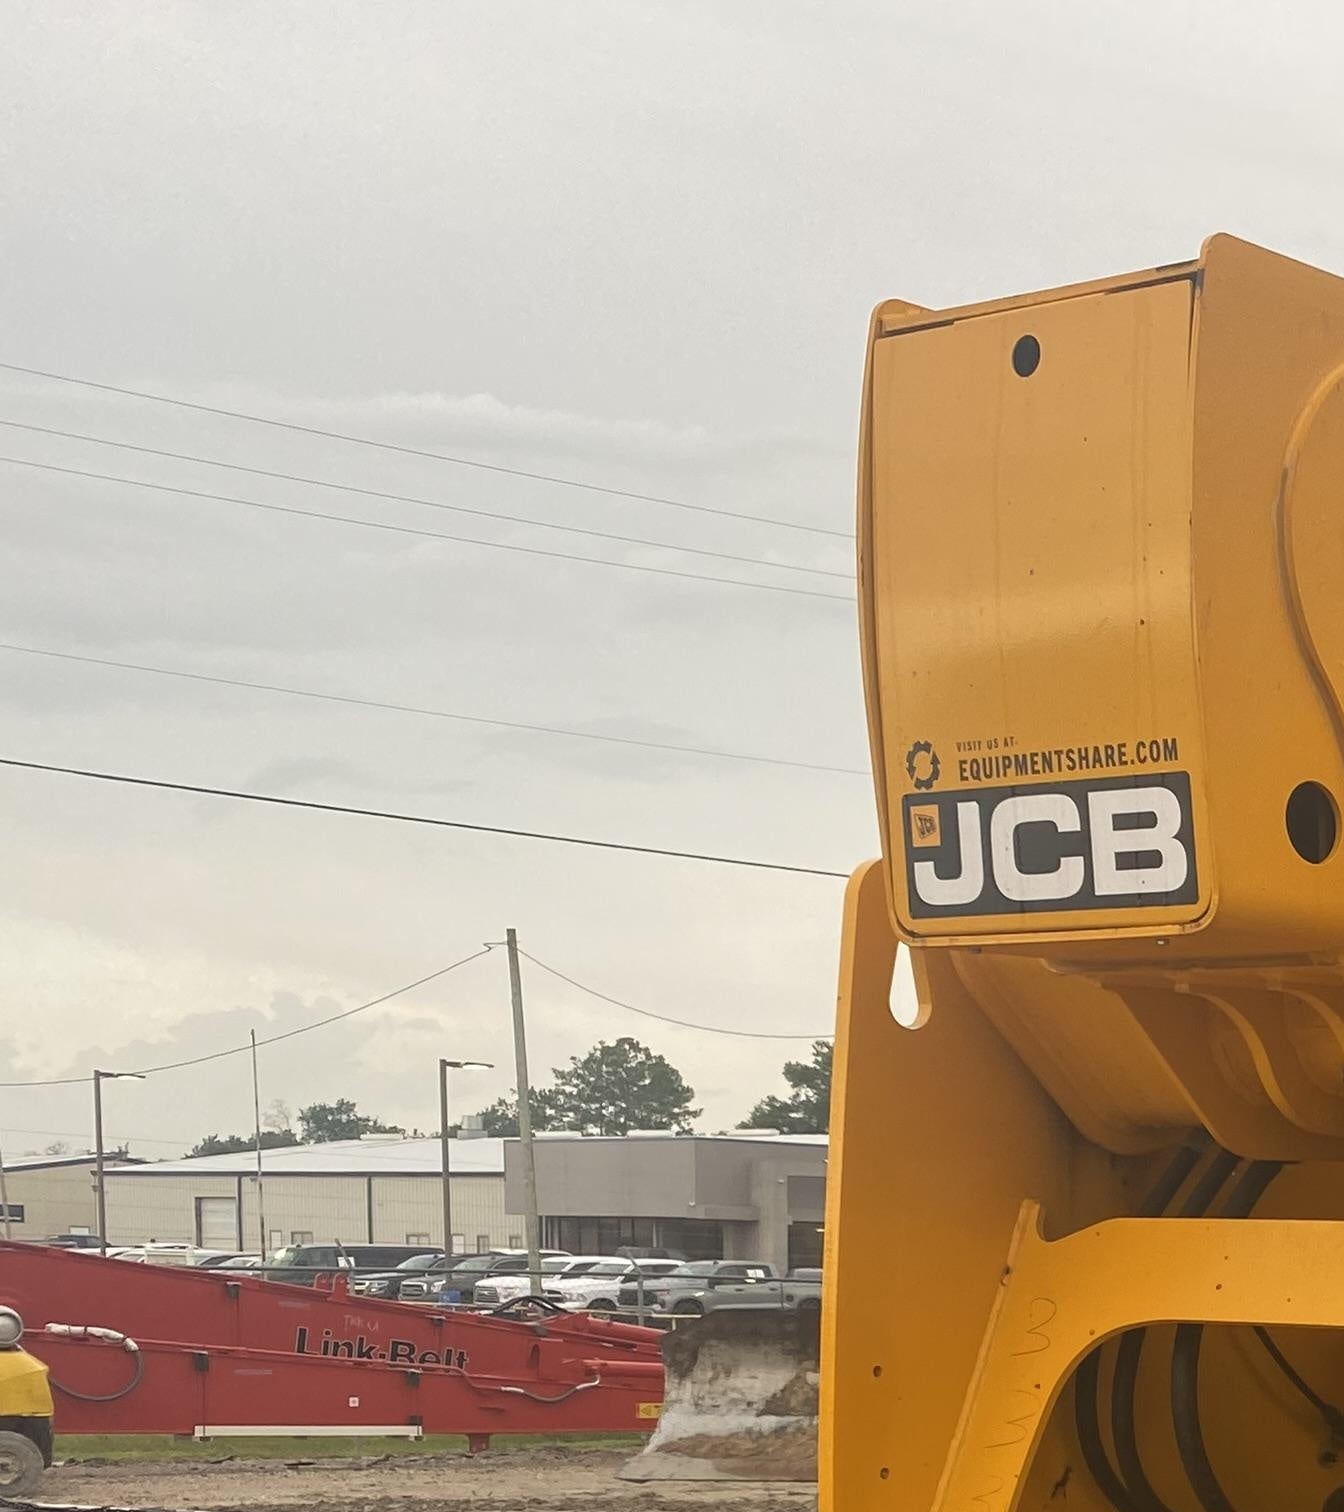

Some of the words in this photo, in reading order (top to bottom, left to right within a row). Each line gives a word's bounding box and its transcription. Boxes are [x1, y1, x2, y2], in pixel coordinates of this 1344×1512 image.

[956, 739, 984, 752] VISIT
[986, 738, 999, 751] US
[958, 737, 1179, 782] EQUIPMENTSHARE.COM
[914, 786, 1189, 906] JCB
